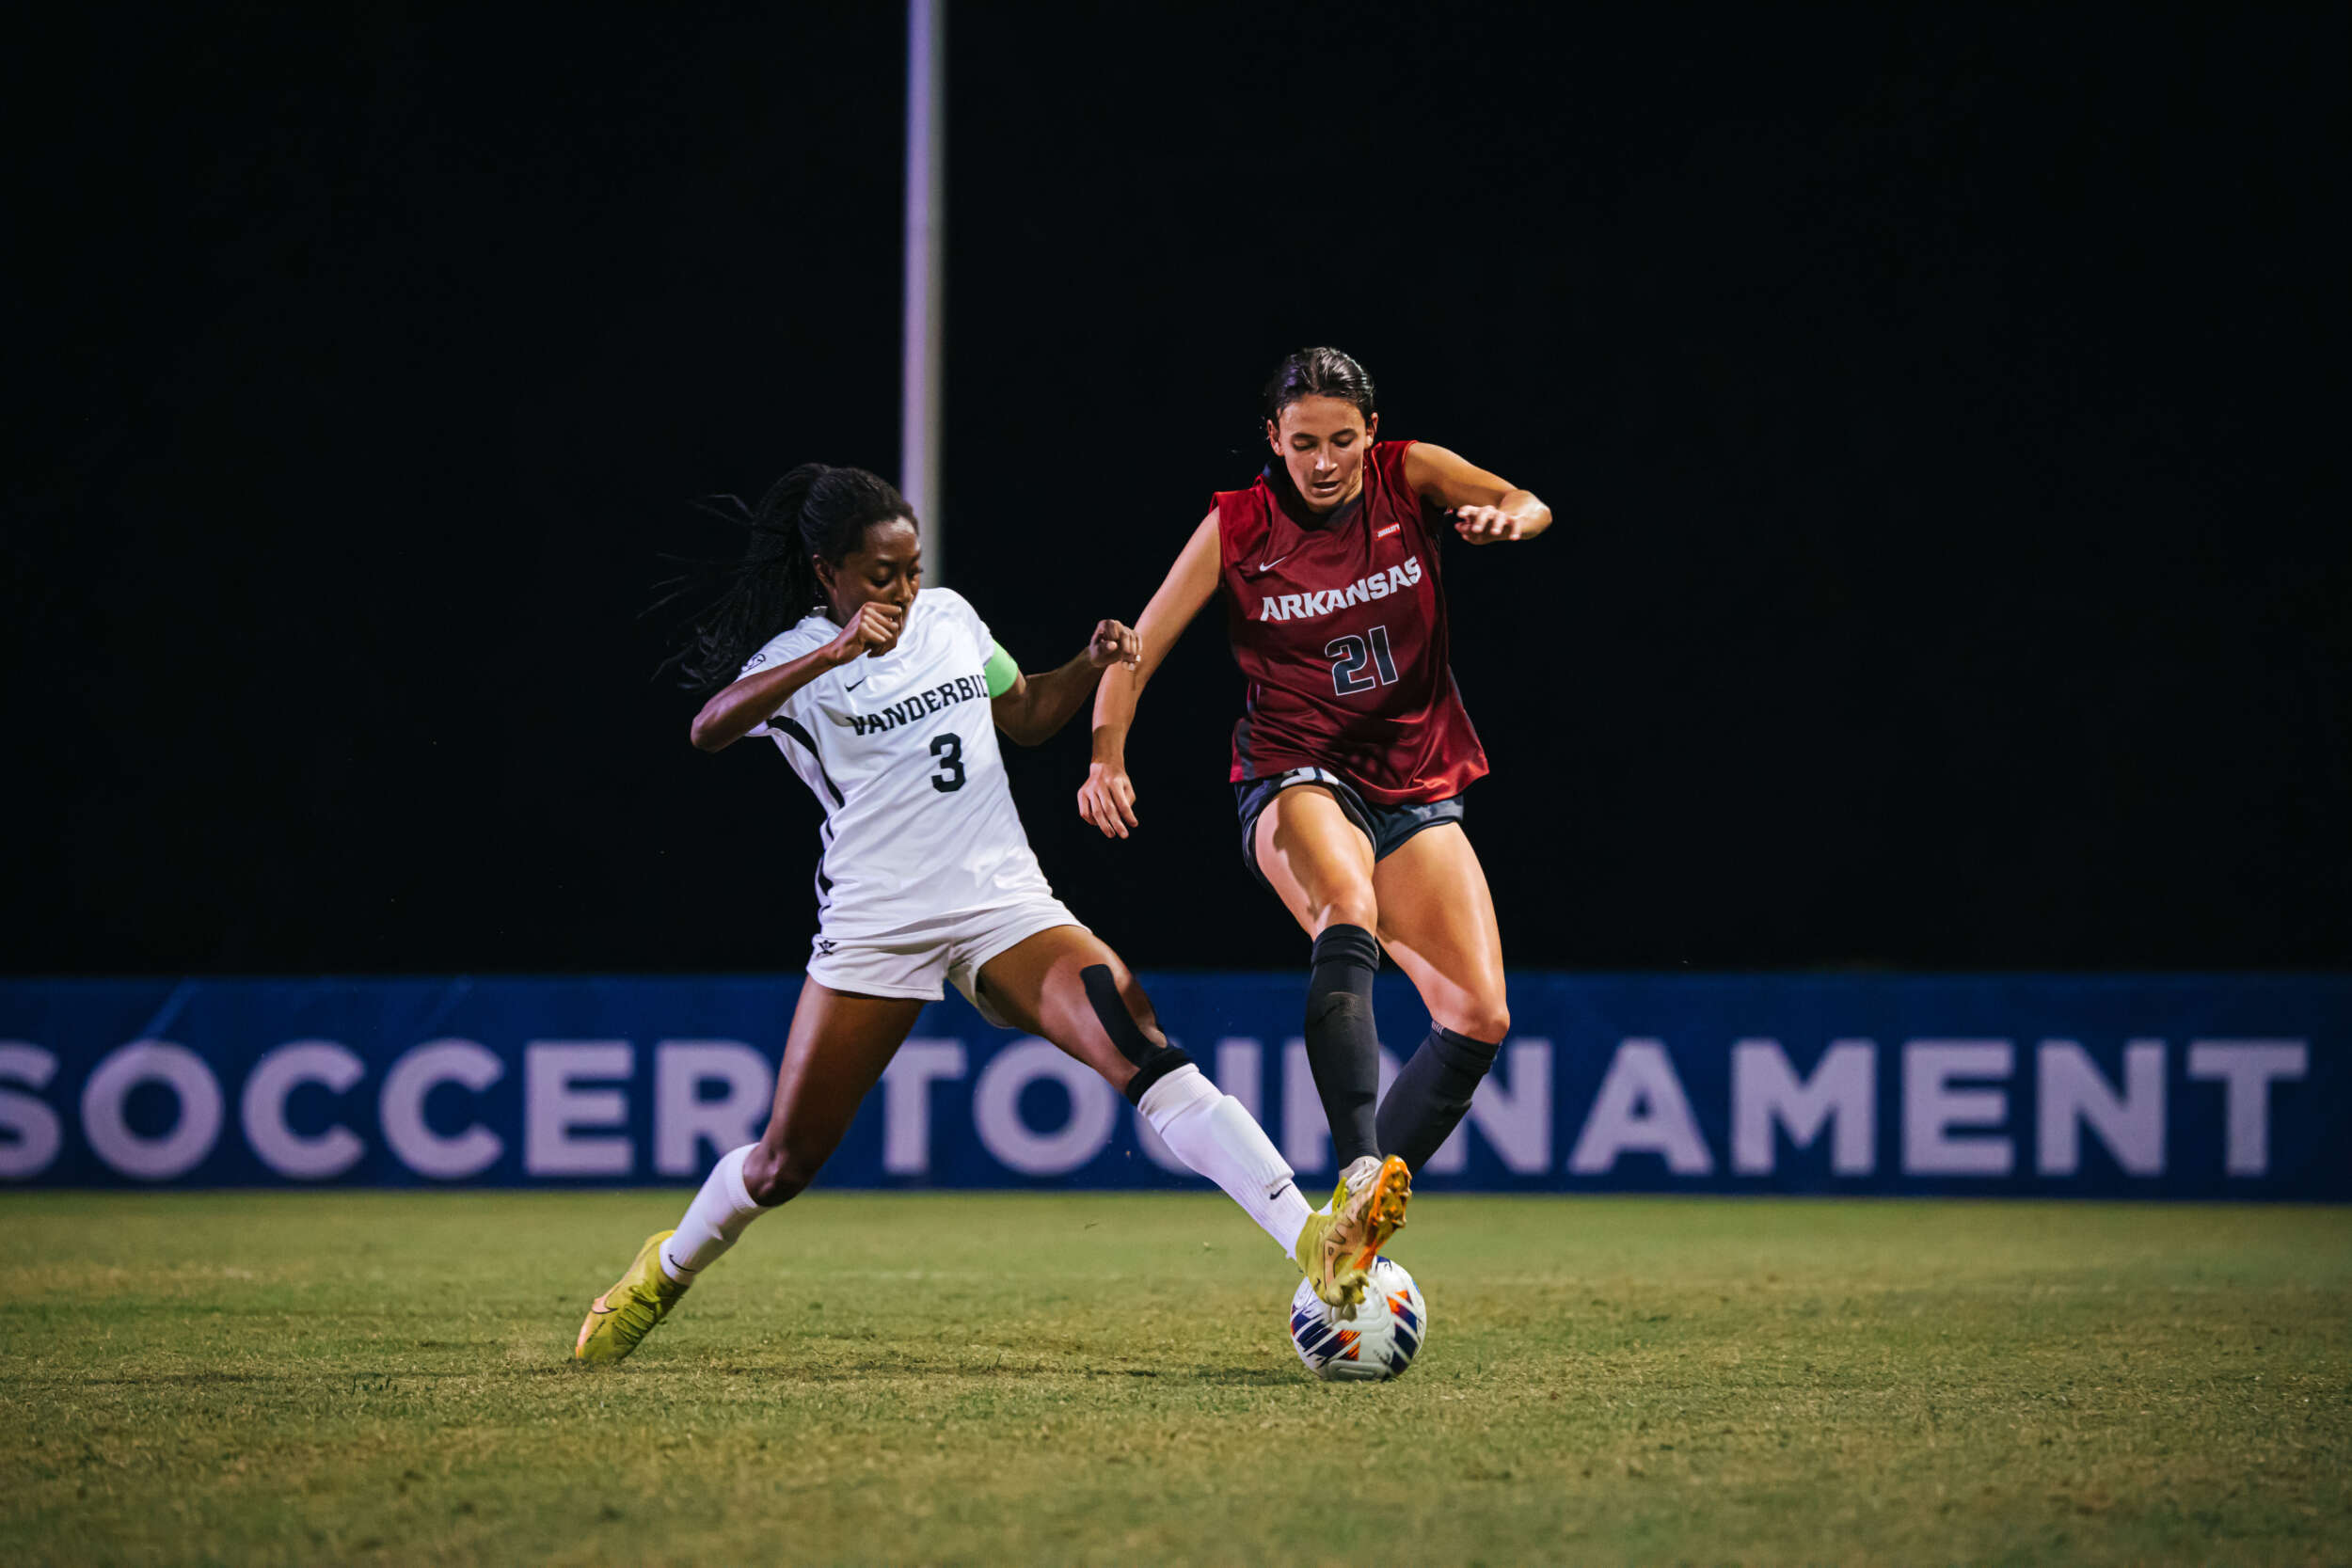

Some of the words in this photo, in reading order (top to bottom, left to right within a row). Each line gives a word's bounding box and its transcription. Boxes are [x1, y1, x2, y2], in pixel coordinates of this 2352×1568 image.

[1259, 556, 1422, 622] ARKANSAS
[1325, 625, 1399, 696] 21
[846, 674, 988, 736] VANDERBIL
[930, 732, 966, 793] 3
[0, 1040, 777, 1180] SOCCER
[881, 1037, 2309, 1176] TONAMENT
